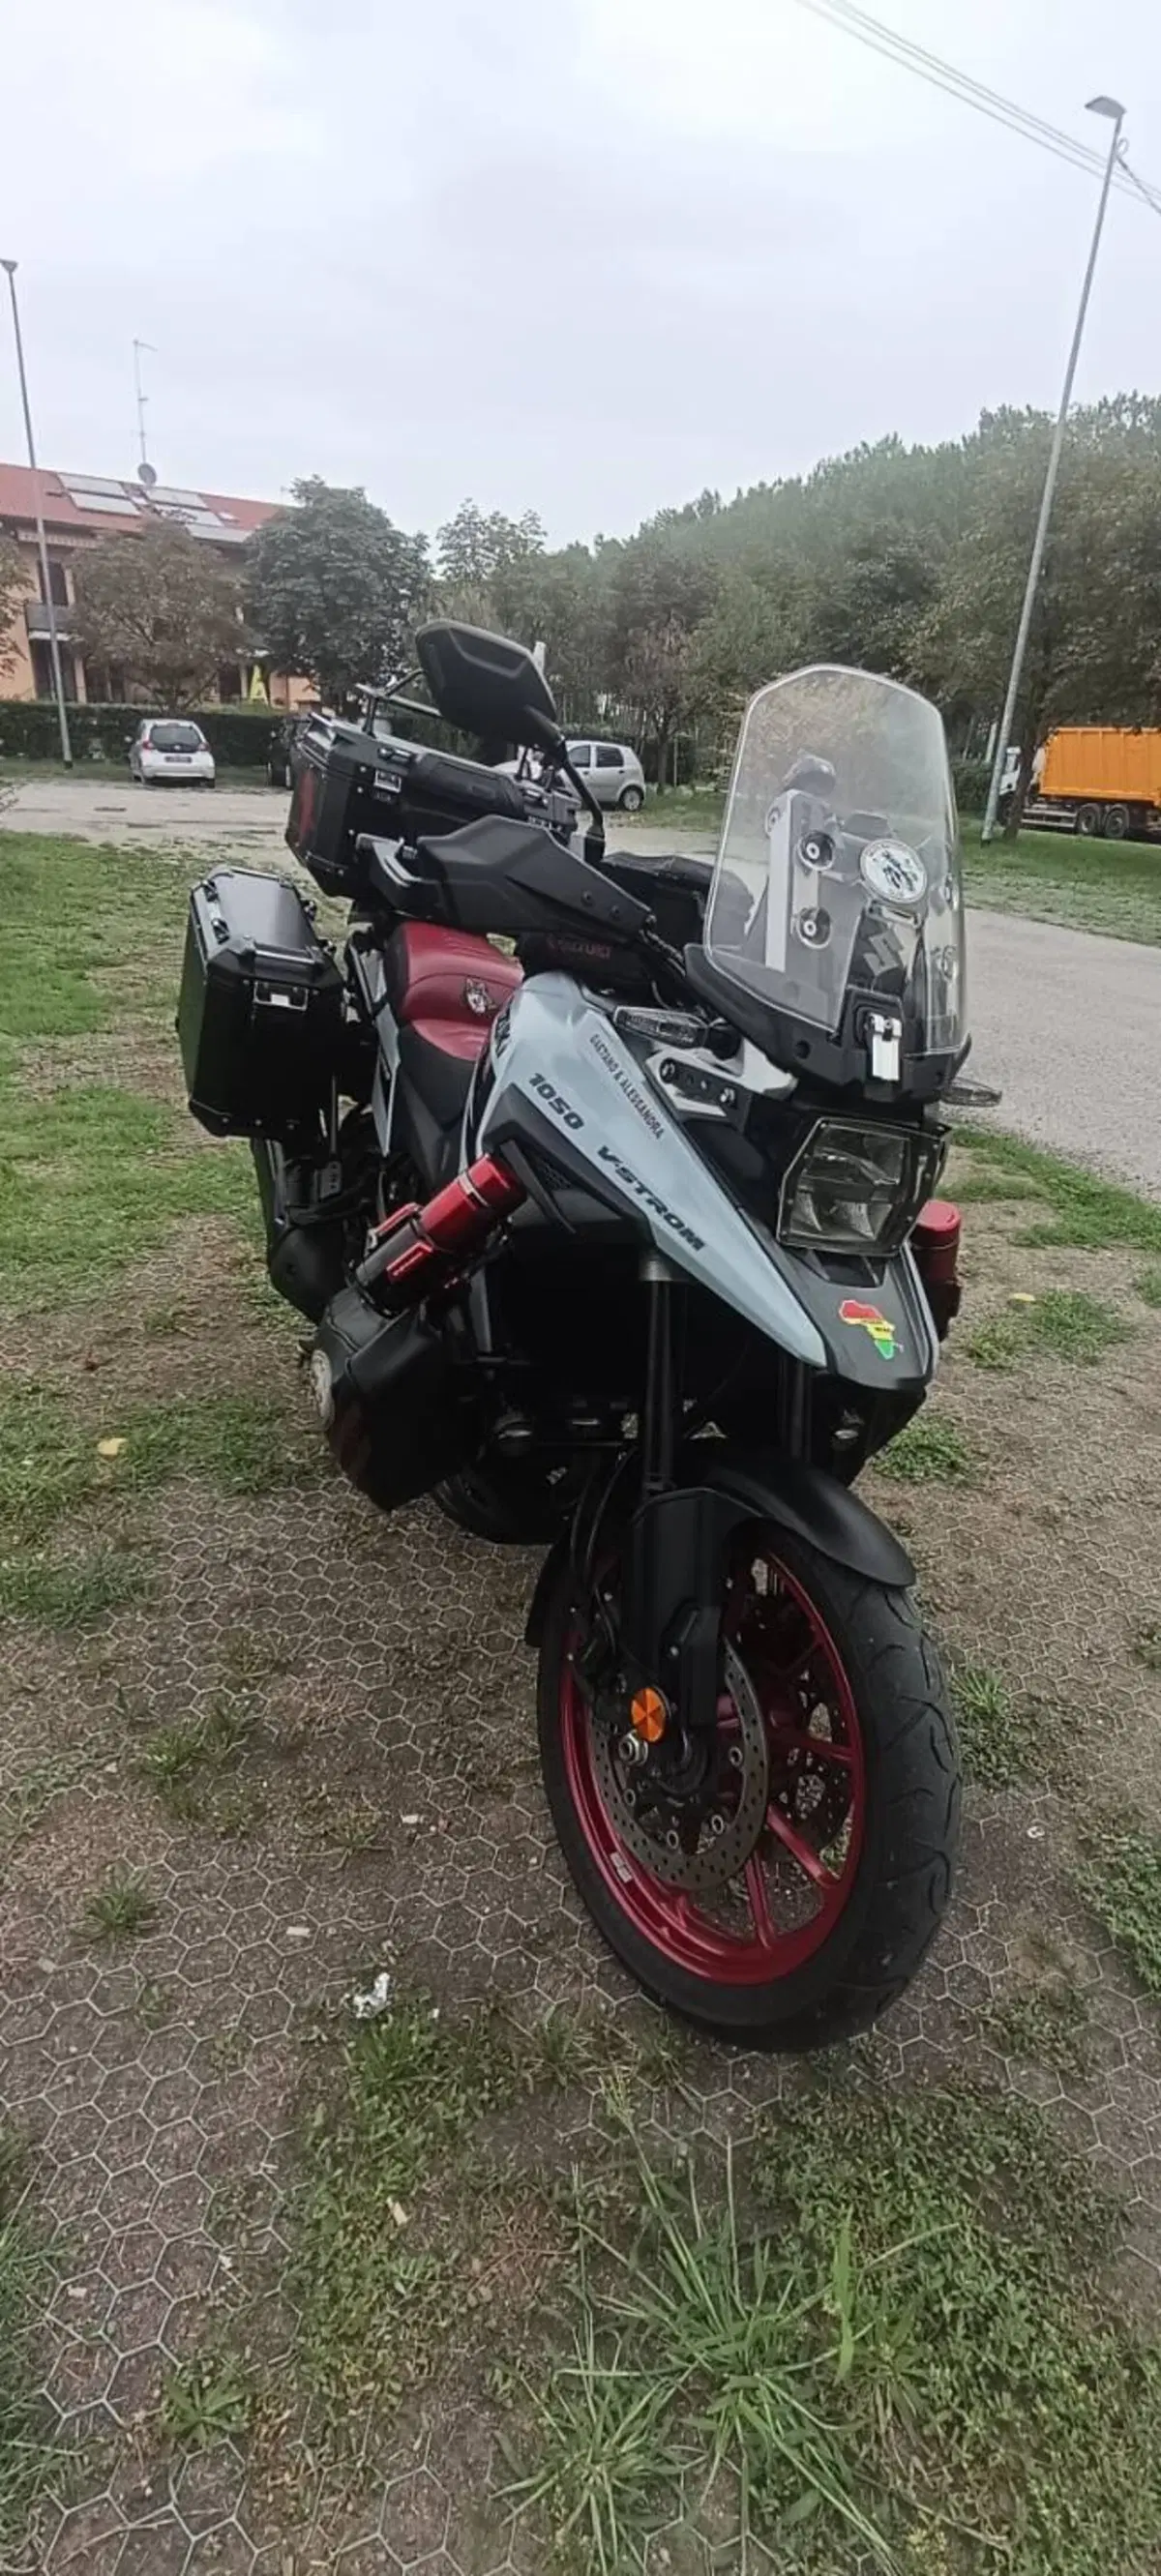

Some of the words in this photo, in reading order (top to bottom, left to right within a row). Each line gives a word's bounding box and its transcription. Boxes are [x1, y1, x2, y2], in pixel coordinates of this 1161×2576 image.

[528, 1072, 585, 1131] 1050
[619, 1078, 665, 1140] ALESSANDRA
[597, 1144, 706, 1252] V-STROM
